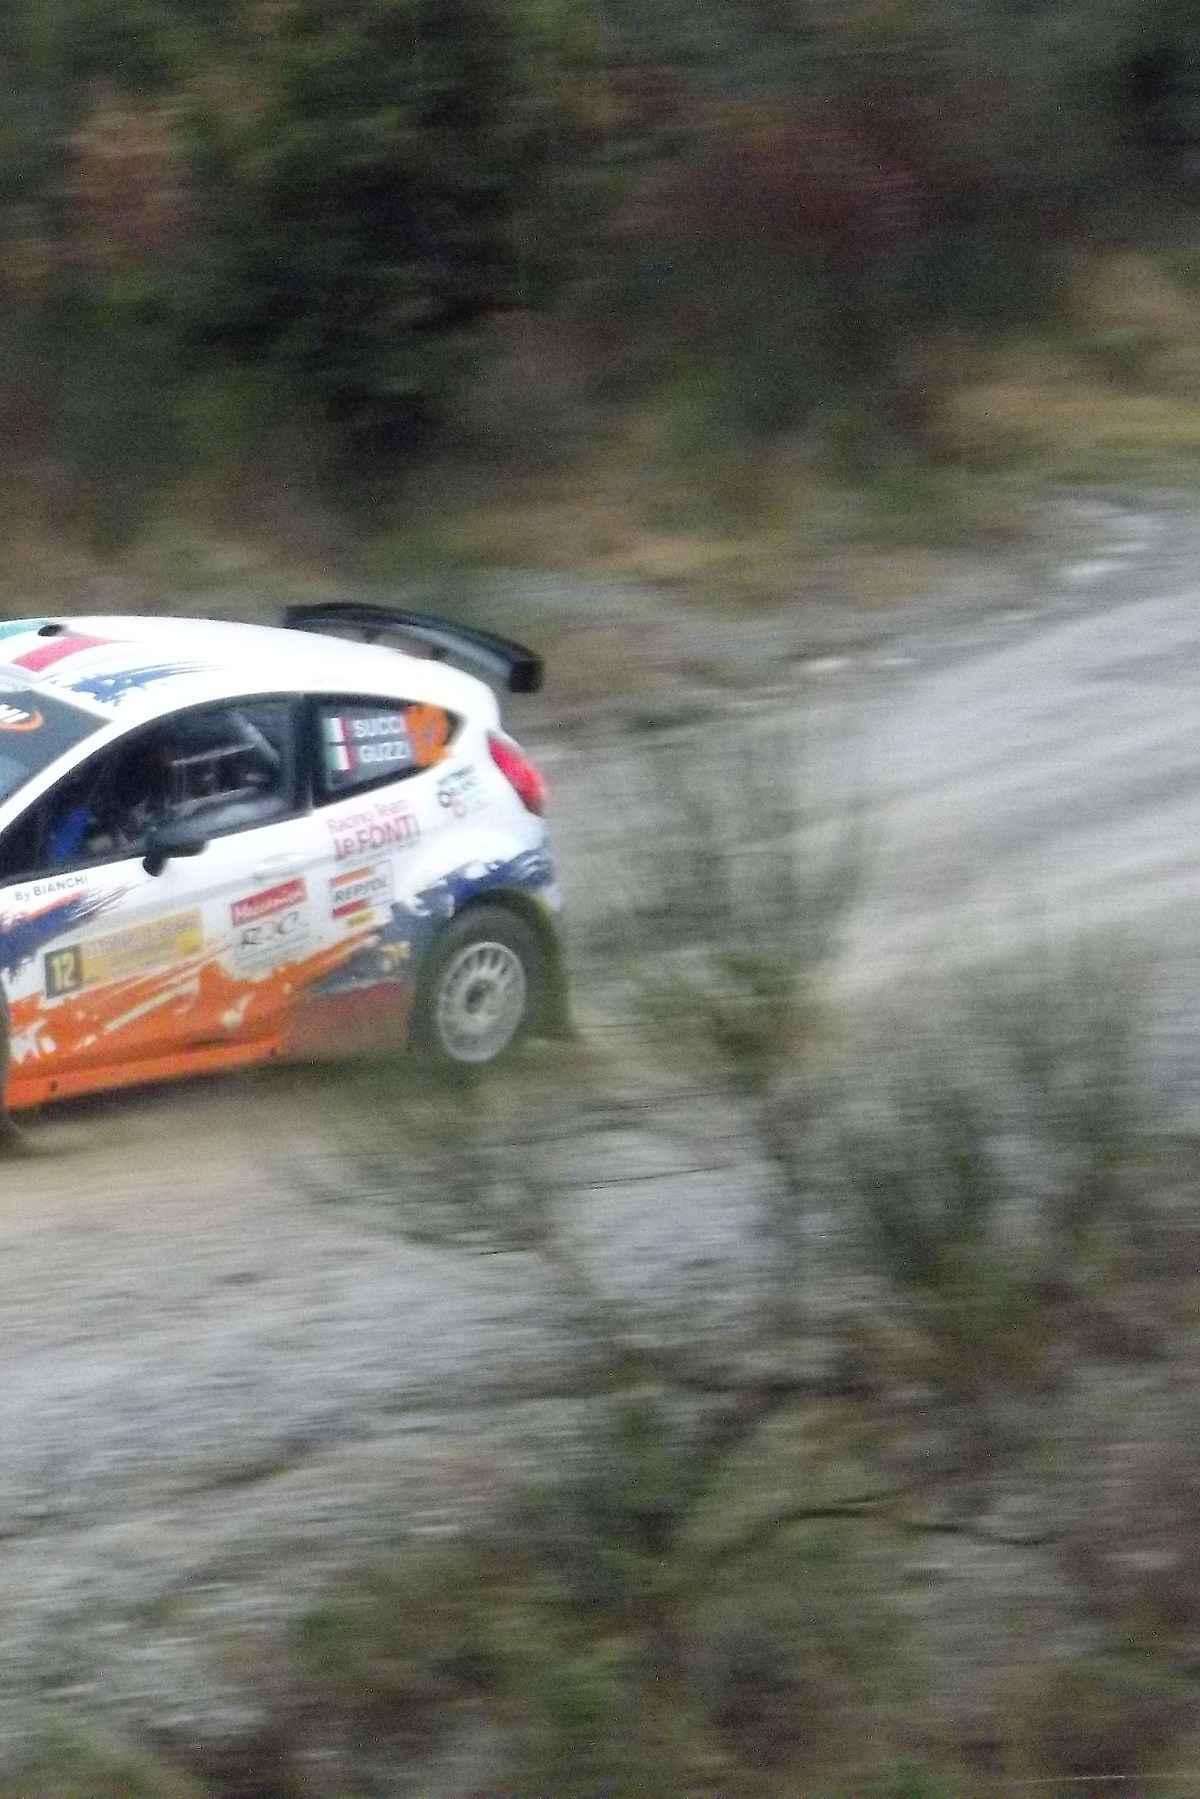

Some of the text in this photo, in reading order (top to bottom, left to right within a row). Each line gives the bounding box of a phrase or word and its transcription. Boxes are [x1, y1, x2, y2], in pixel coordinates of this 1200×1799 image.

[14, 876, 90, 903] By BIANCHI
[333, 876, 388, 903] REPSOL
[53, 952, 75, 990] 12
